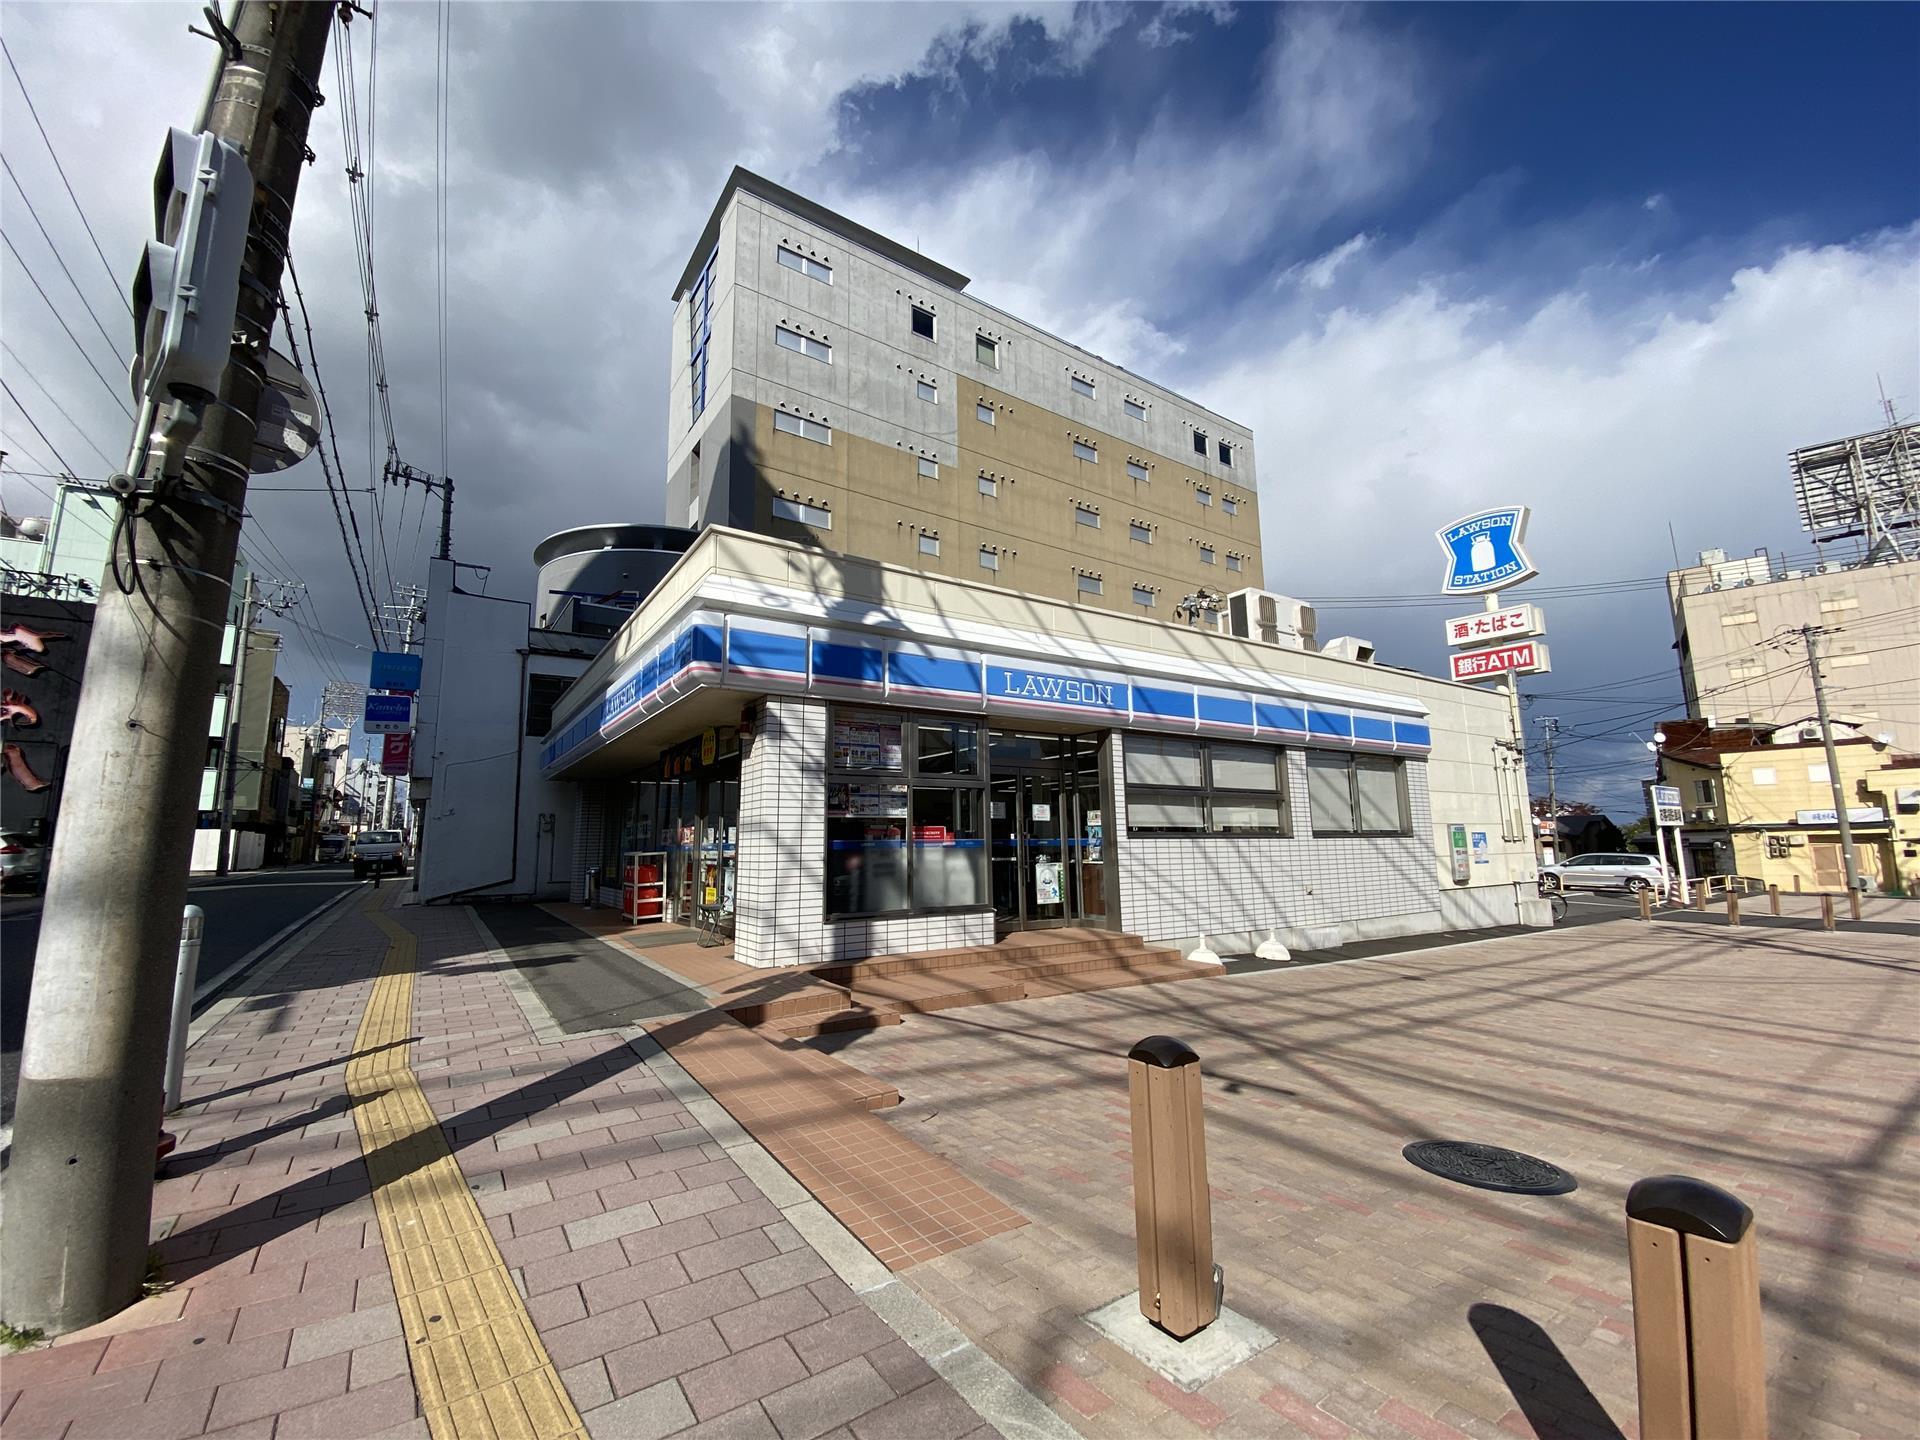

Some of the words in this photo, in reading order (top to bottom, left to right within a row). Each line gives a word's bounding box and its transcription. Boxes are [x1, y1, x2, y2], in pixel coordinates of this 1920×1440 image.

[1447, 515, 1513, 543] LAWSON
[1453, 561, 1519, 586] STATION
[1457, 648, 1531, 675] 銀行ATM
[605, 679, 637, 721] LAWSON
[1003, 671, 1115, 706] LAWSON
